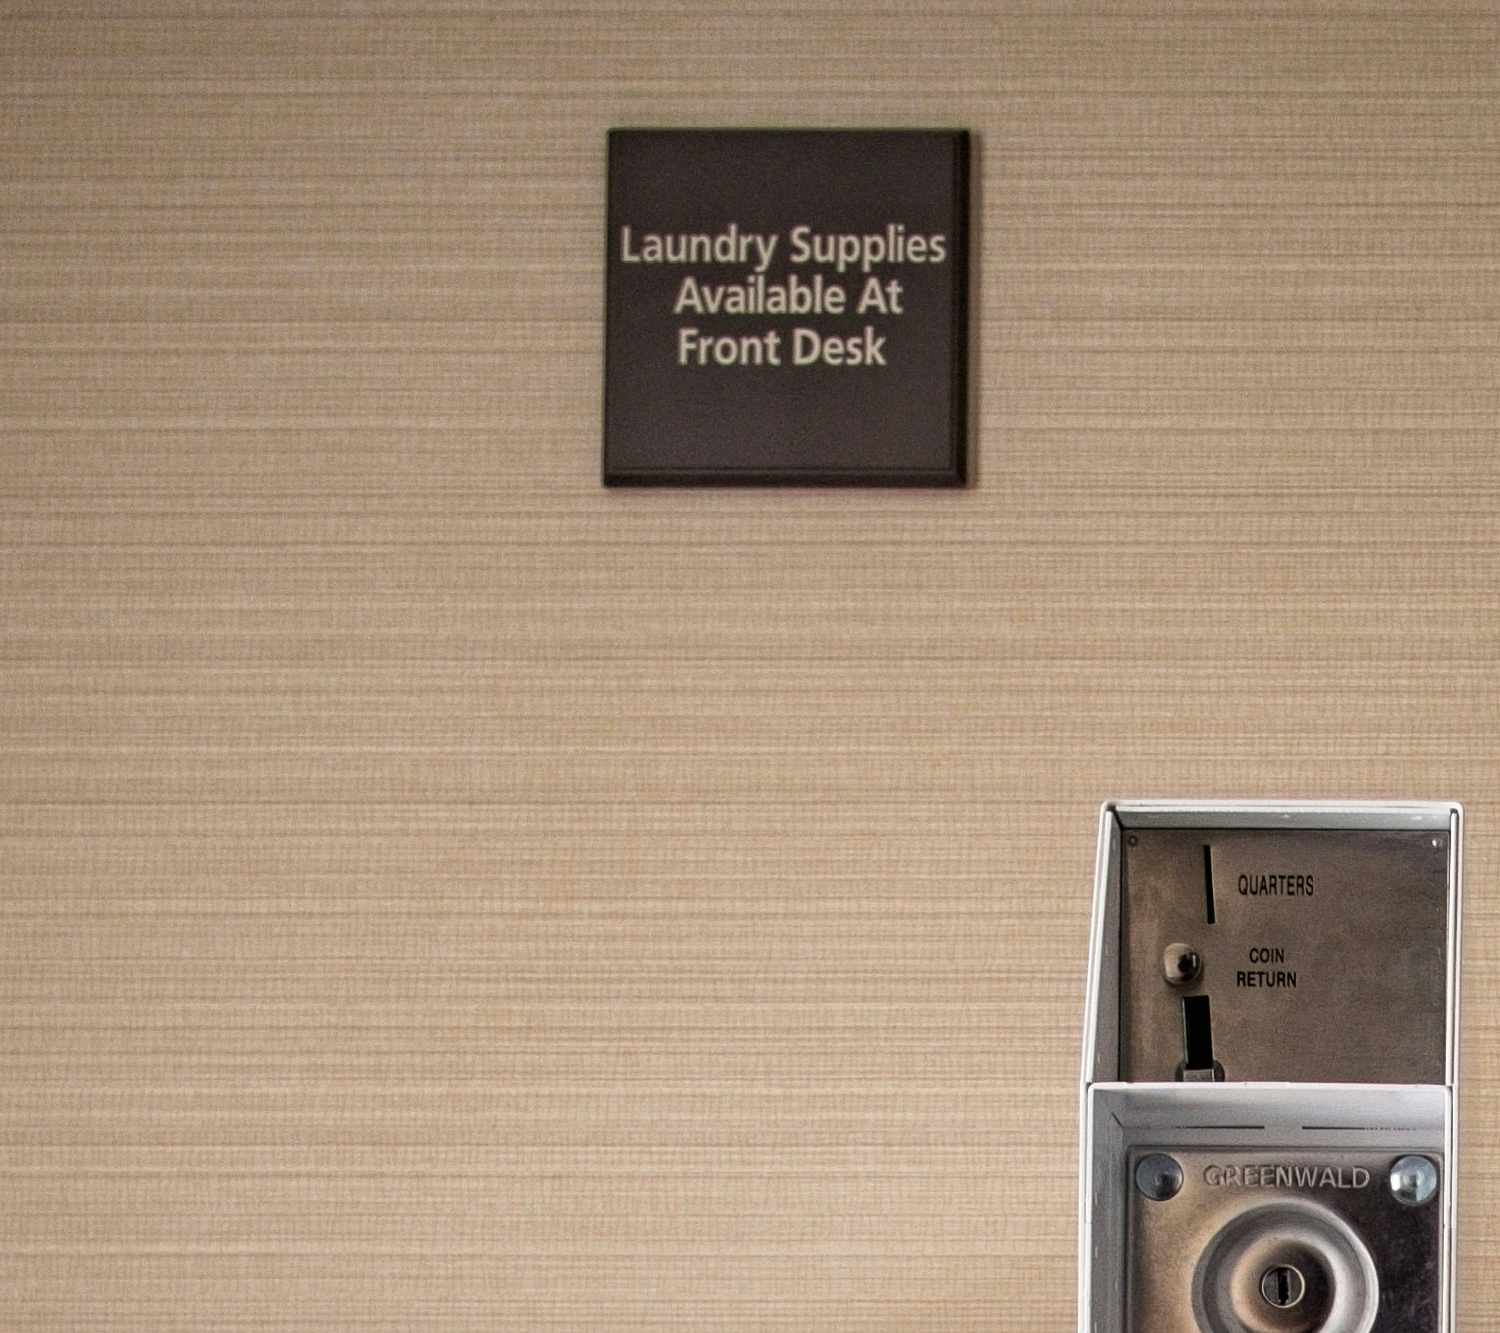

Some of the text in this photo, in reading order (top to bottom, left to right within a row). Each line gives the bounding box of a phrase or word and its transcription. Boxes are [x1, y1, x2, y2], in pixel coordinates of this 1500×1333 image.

[620, 224, 947, 272] Laundry Supplies
[674, 275, 904, 315] Available At
[678, 326, 886, 366] Front Desk
[1237, 873, 1314, 897] QUARTERS
[1249, 947, 1286, 964] COIN
[1236, 970, 1298, 988] RETURN
[1203, 1164, 1370, 1189] GREENWALD
